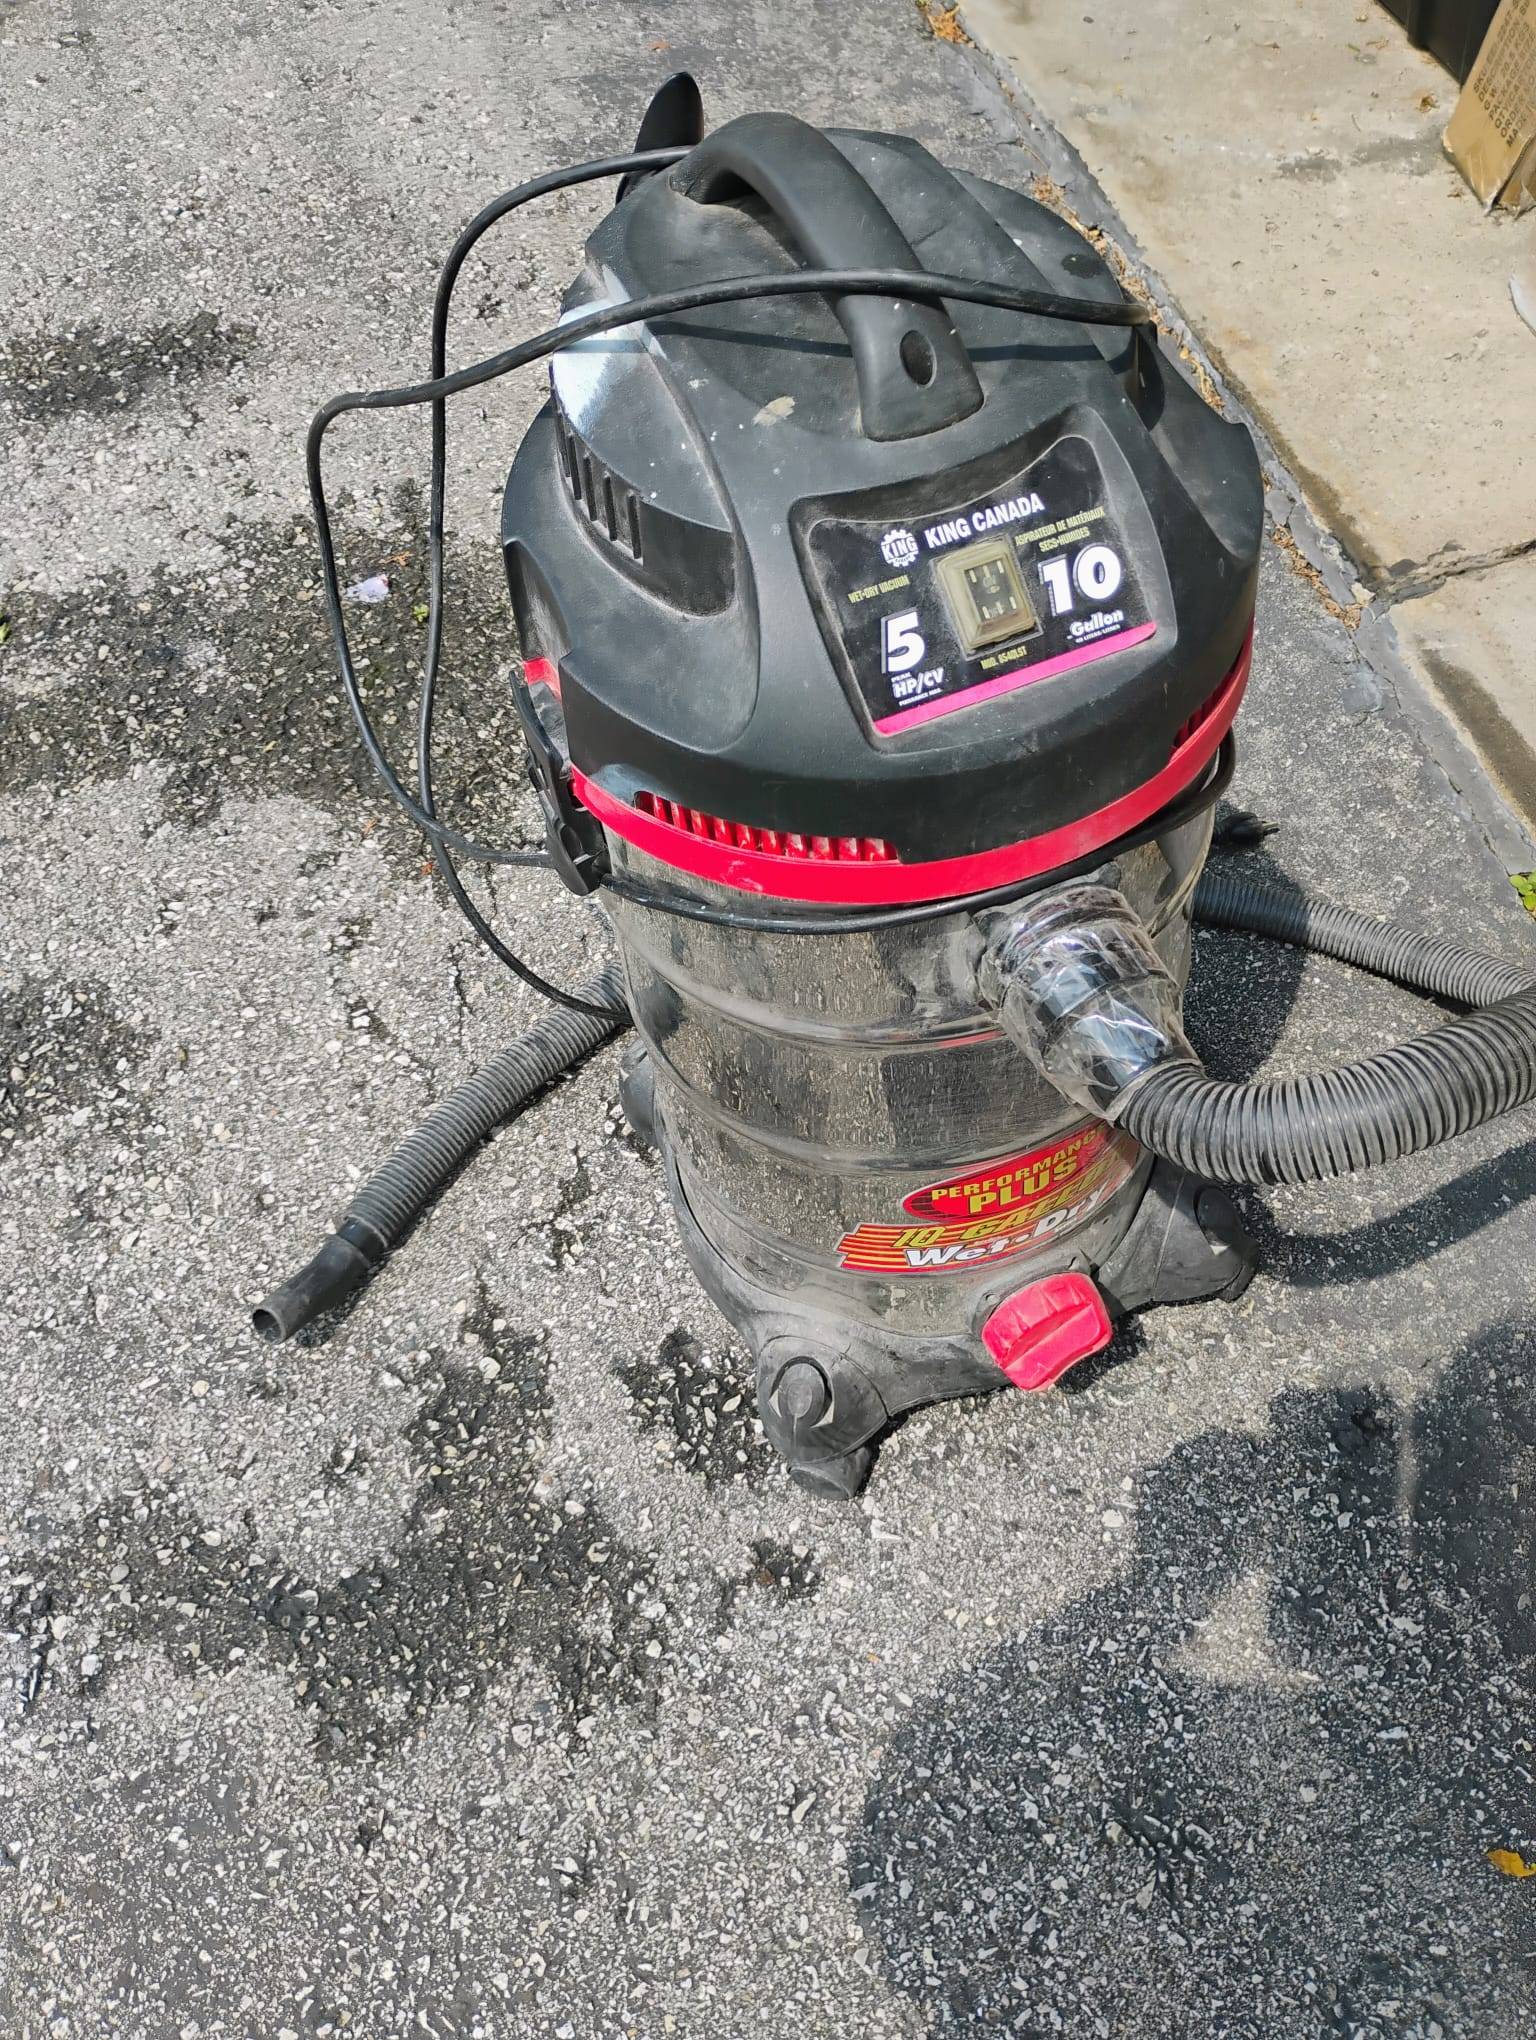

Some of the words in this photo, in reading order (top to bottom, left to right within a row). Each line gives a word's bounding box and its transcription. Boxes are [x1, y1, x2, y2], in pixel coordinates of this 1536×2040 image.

[924, 518, 972, 549] KING
[971, 493, 1046, 532] CANADA
[1014, 523, 1057, 547] ASPIRATEUR
[1056, 519, 1068, 533] DE
[881, 536, 920, 562] KING
[878, 574, 911, 594] VACUUM
[1038, 542, 1122, 618] 10
[1069, 609, 1125, 637] Gallon
[881, 607, 925, 674] 5
[892, 666, 944, 699] HP/CV
[970, 1155, 1078, 1214] PLUS
[892, 1227, 947, 1248] 10
